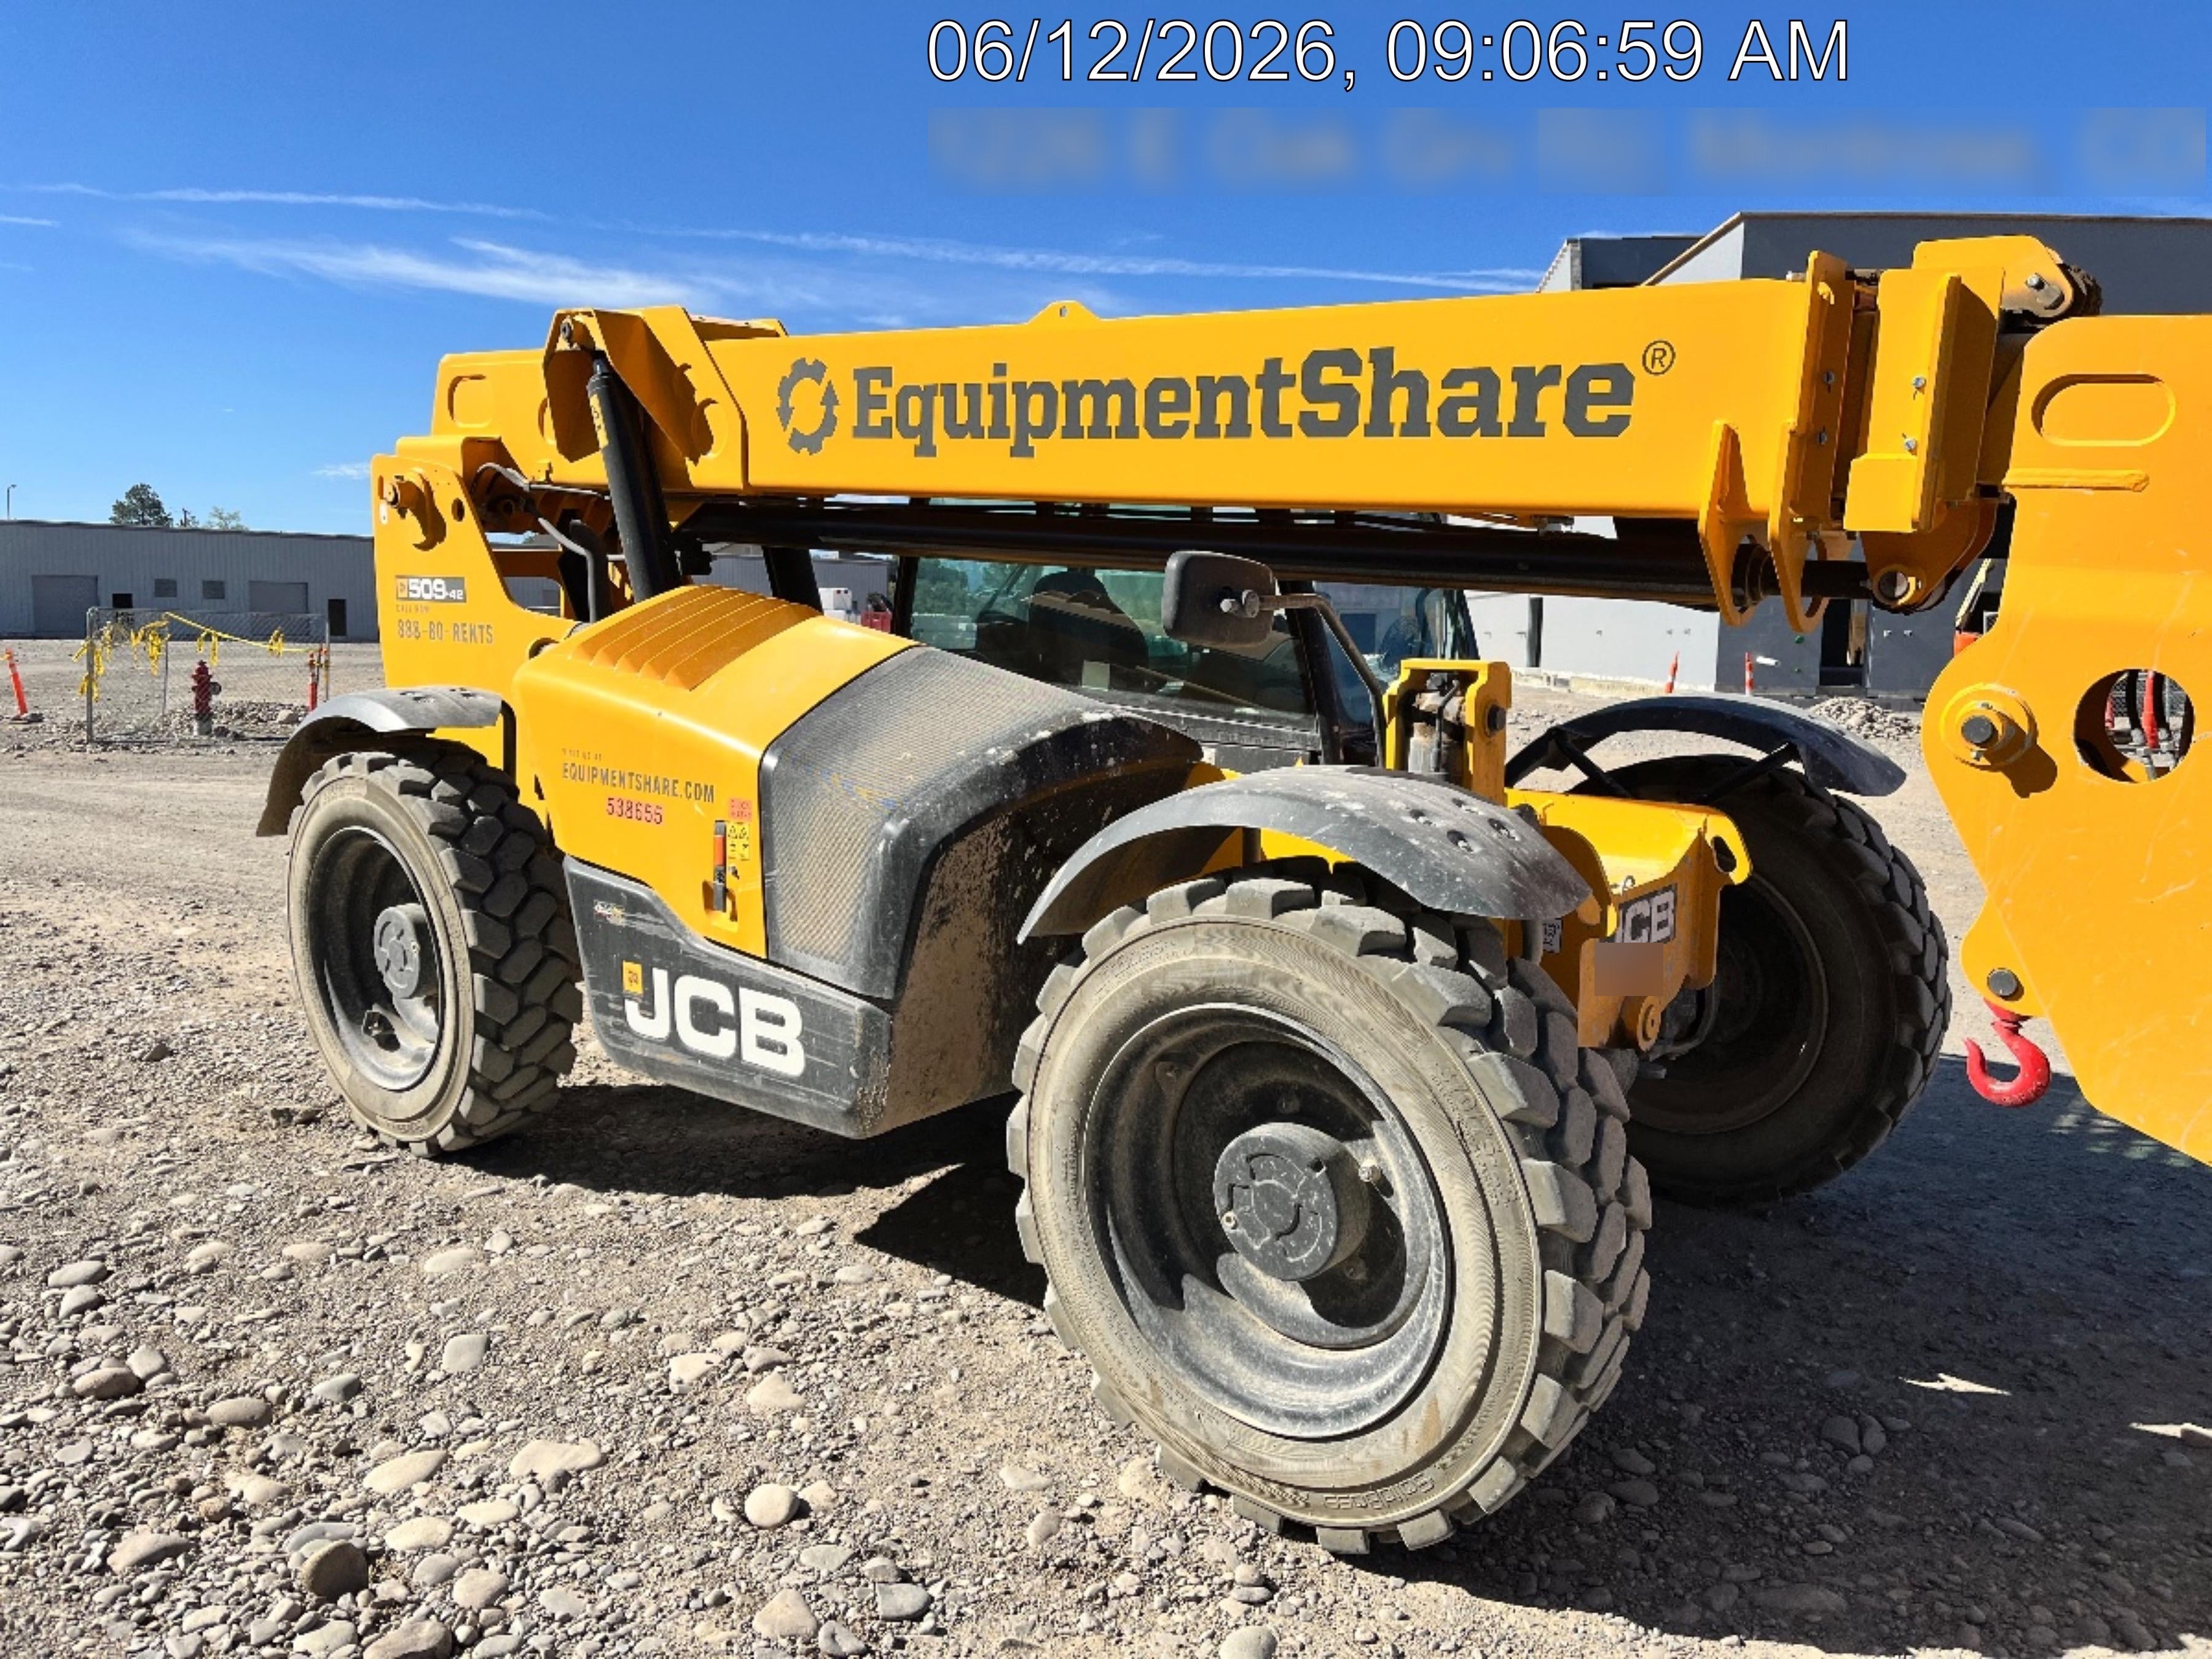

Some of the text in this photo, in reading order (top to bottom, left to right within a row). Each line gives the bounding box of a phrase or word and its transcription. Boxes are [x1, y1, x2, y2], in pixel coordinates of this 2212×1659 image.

[852, 347, 1636, 458] EquipmentShare
[408, 578, 464, 600] 509-42
[562, 763, 715, 803] EQUIPMENTSHARE.COM
[606, 798, 663, 825] 538655
[624, 967, 806, 1077] JCB
